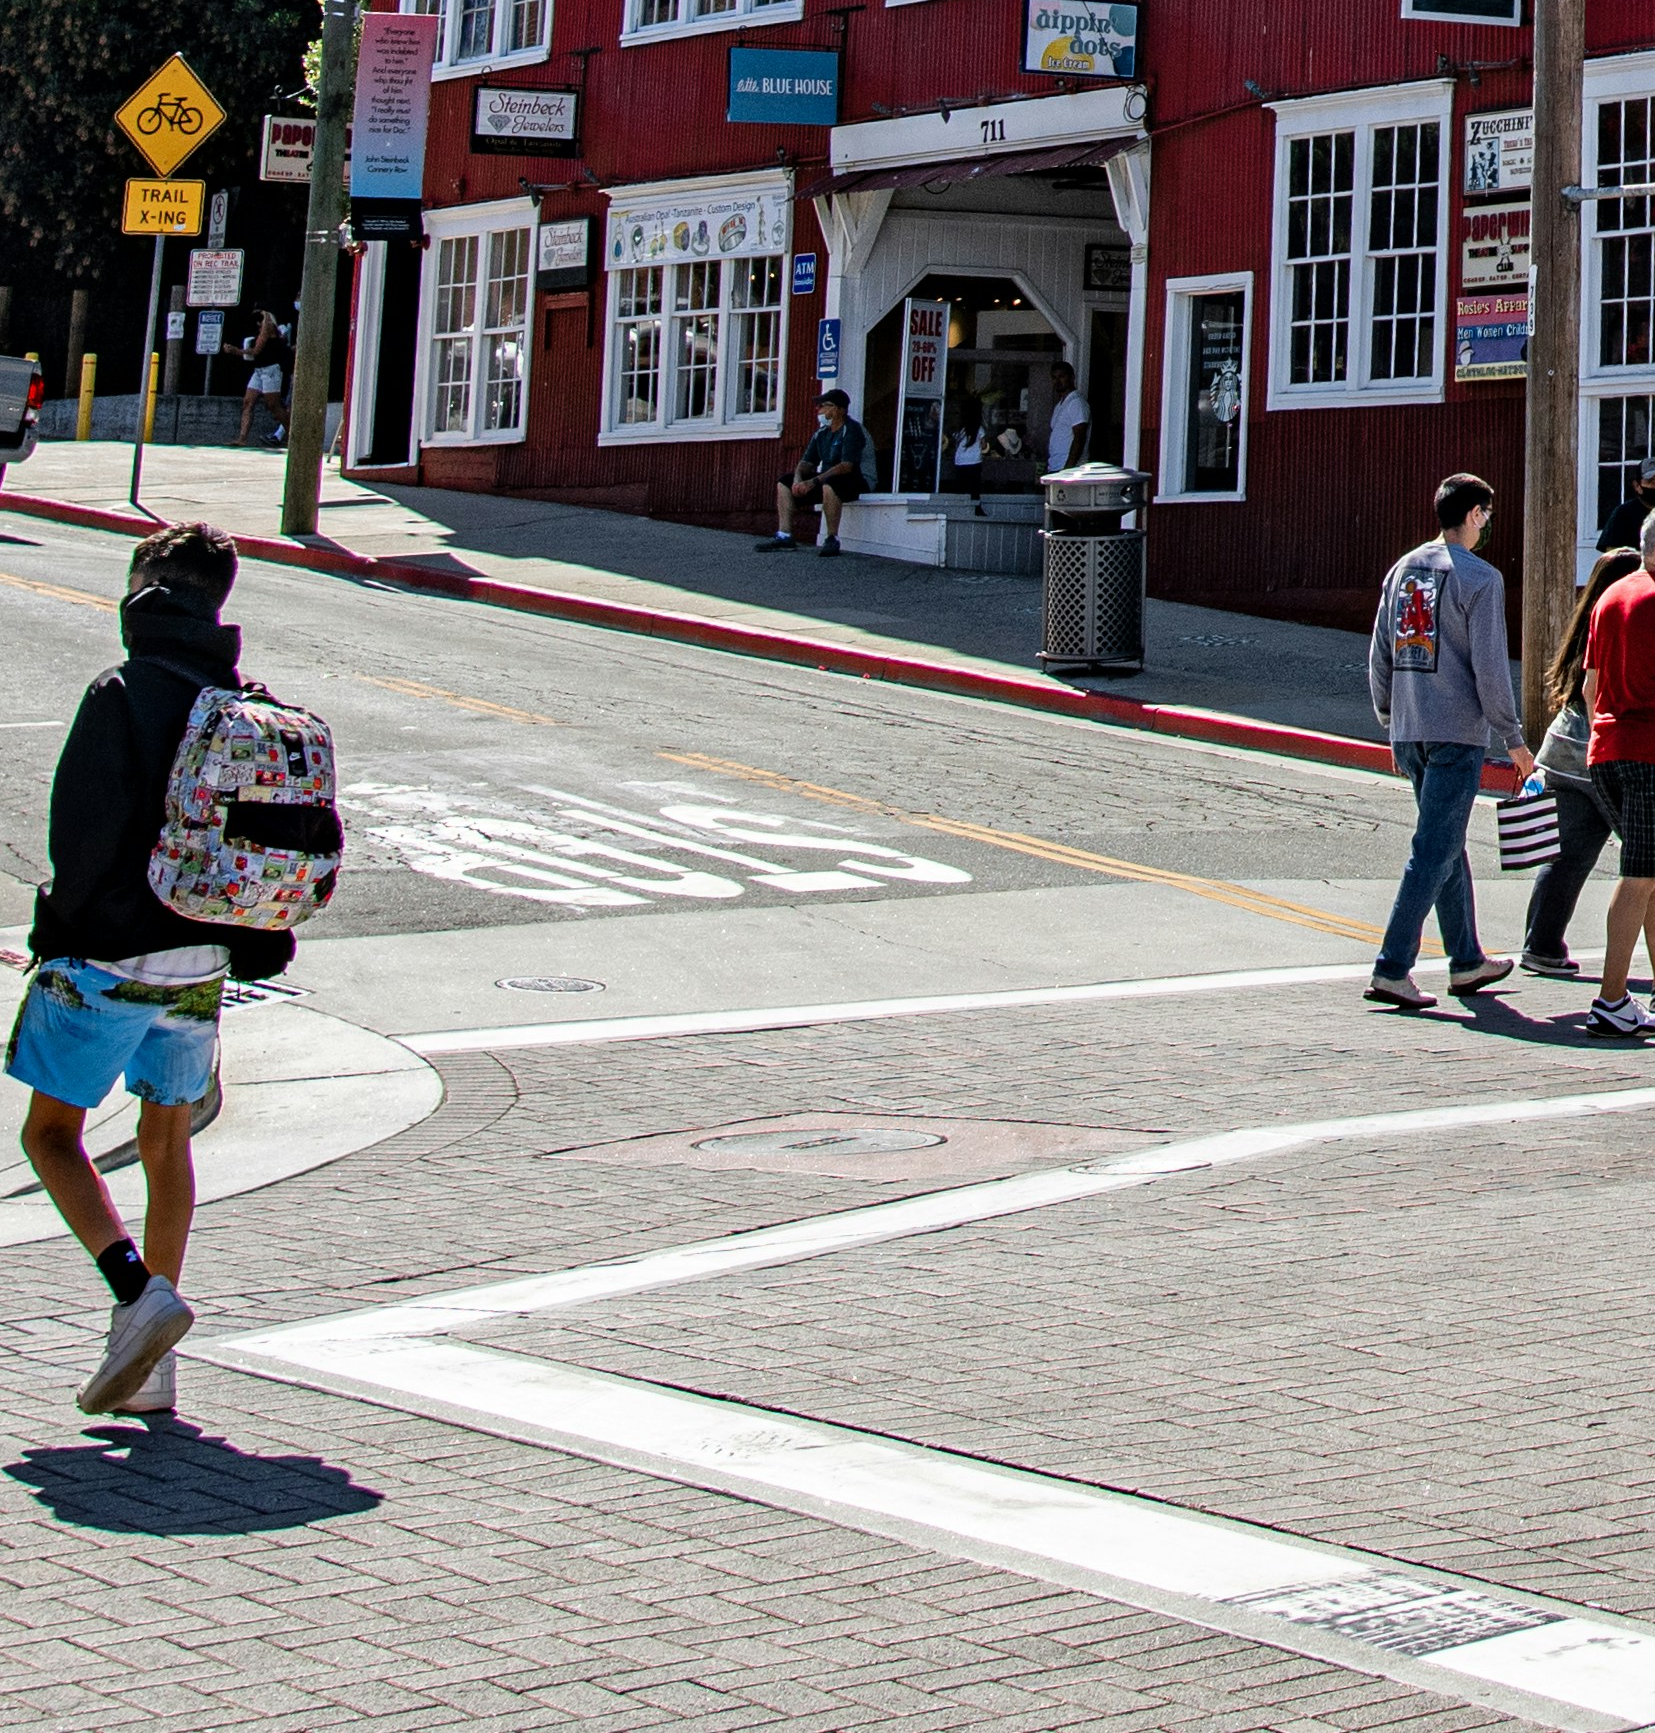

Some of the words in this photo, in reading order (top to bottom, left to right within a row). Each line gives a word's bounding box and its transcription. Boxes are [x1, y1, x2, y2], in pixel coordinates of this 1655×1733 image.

[1069, 34, 1122, 57] dots
[762, 77, 792, 94] BLUE
[795, 78, 833, 96] HOUSE
[489, 92, 566, 116] Steinbeck
[511, 115, 565, 134] Jewelers
[980, 119, 1006, 143] 711
[141, 188, 189, 203] TRAIL
[707, 201, 732, 215] Custom
[732, 200, 756, 213] Design
[140, 210, 187, 225] X-ING
[795, 262, 814, 275] ATM
[1457, 300, 1489, 316] Rosie's
[1495, 299, 1528, 313] Appar
[910, 309, 942, 337] SALE
[1457, 328, 1473, 340] Men
[912, 356, 936, 382] OFF
